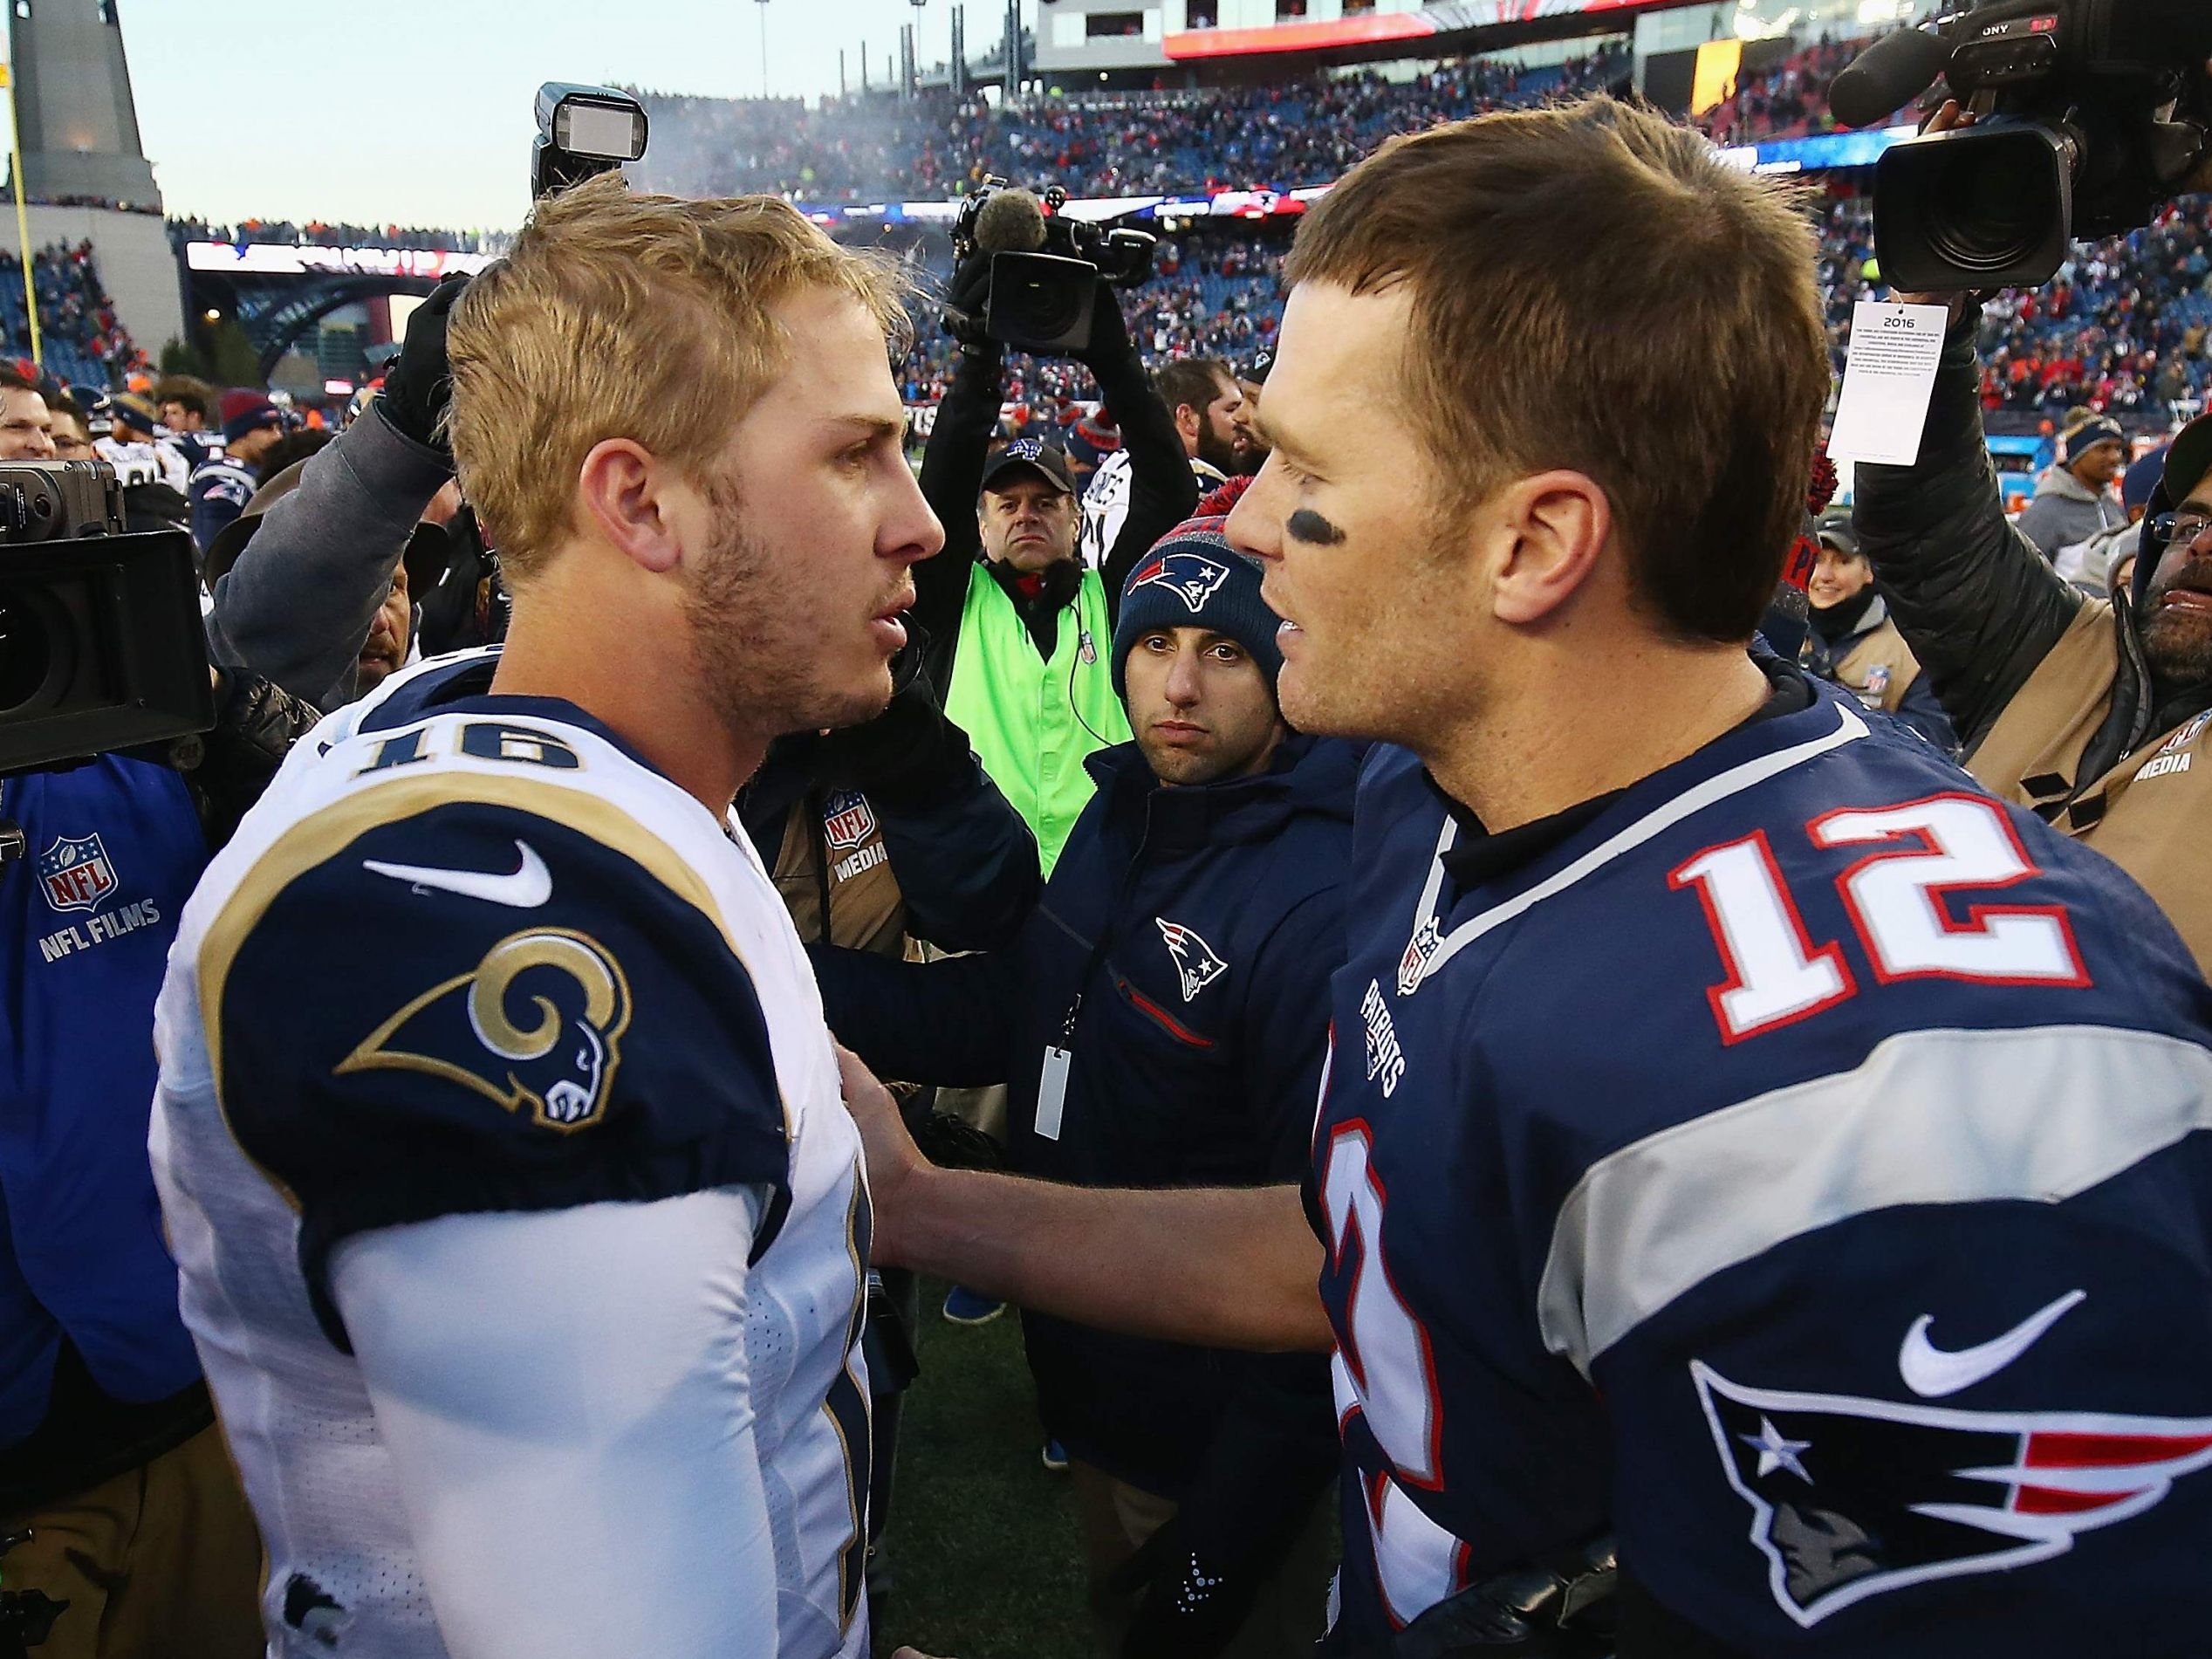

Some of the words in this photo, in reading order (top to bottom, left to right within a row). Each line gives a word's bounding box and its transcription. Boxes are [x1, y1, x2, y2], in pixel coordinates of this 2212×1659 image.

[1982, 24, 2009, 37] ONY
[1883, 317, 1916, 329] 2016
[347, 723, 587, 778] 16
[2133, 752, 2192, 783] MEDIA
[826, 808, 870, 842] NFL
[47, 862, 111, 904] NFL
[834, 841, 888, 883] MEDIA
[39, 926, 91, 963] NFL
[86, 898, 161, 944] FILMS
[1667, 791, 2093, 1047] 12
[1359, 977, 1406, 1099] PATRIOTS
